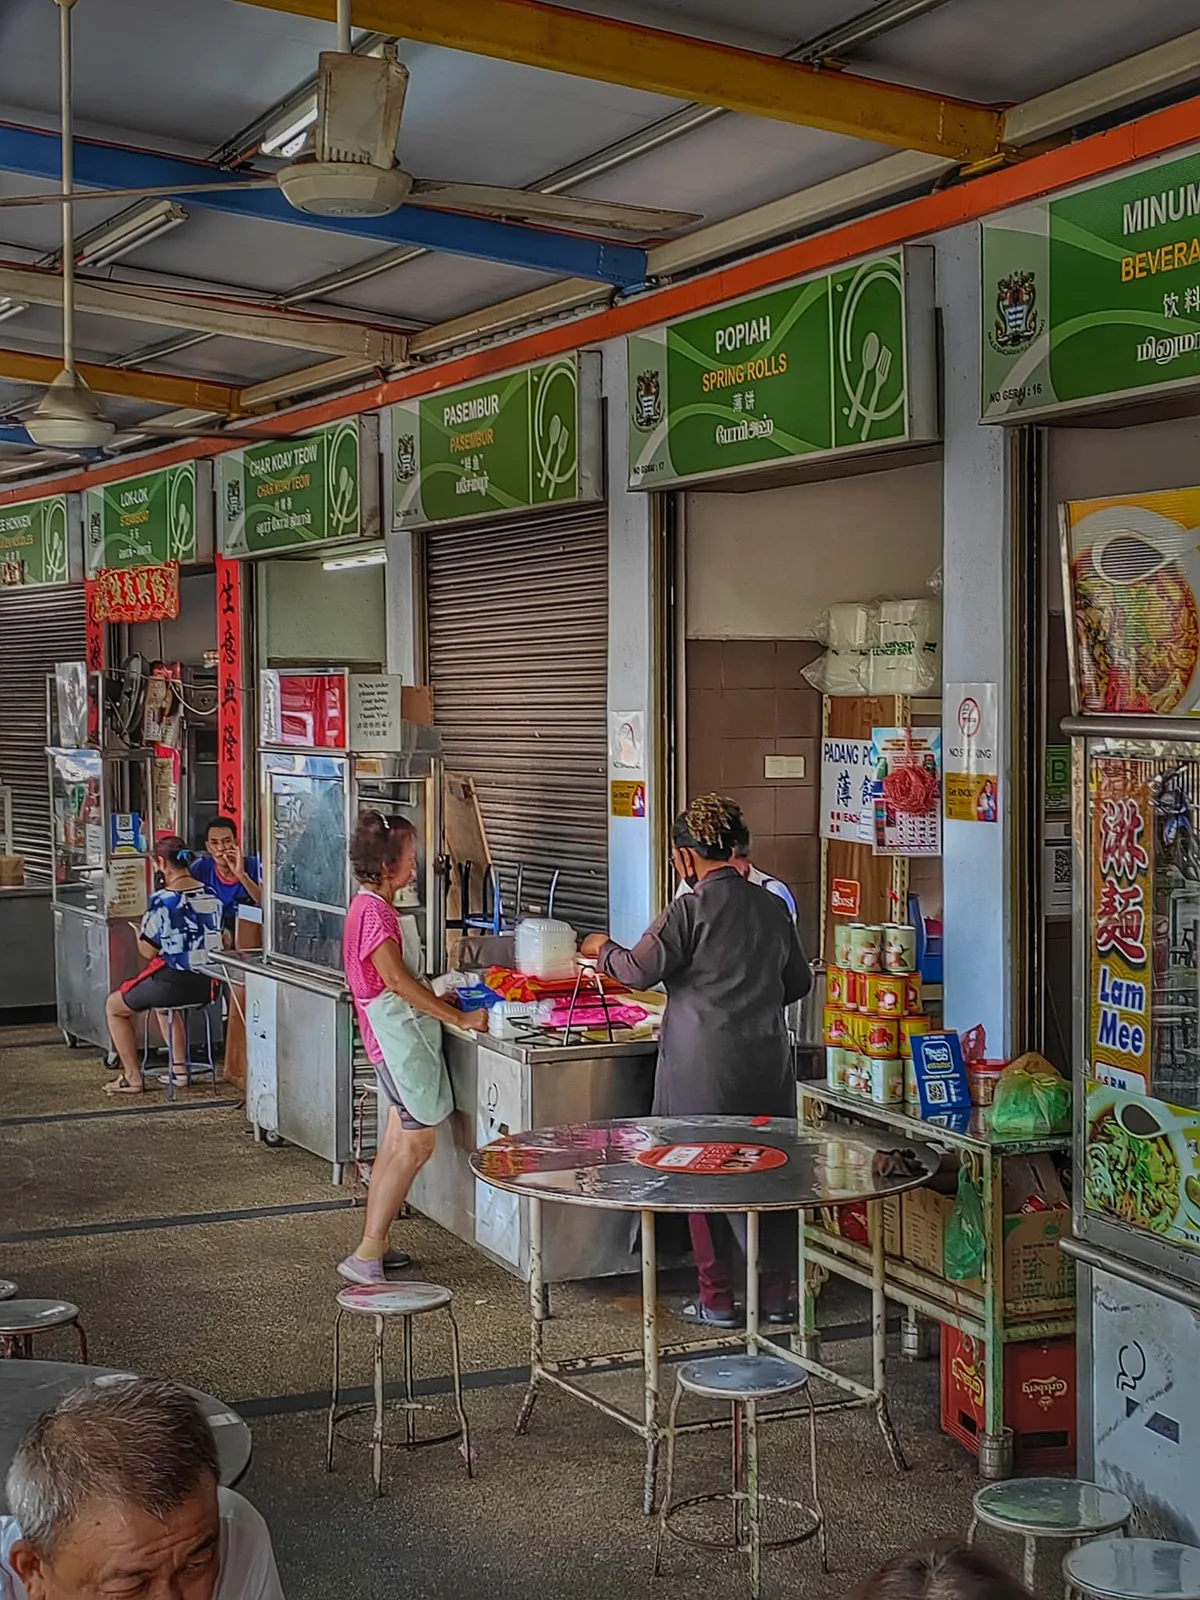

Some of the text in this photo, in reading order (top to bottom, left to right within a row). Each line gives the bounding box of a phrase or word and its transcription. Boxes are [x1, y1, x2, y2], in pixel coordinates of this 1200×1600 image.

[715, 315, 771, 354] POPIAH
[702, 353, 788, 392] SPRING ROLLS
[1032, 383, 1043, 395] 16
[443, 394, 500, 427] PASEMBUR
[293, 444, 318, 466] TEOW
[450, 428, 494, 454] PASEMBUR
[824, 743, 859, 765] PADANG
[1100, 966, 1145, 1012] Lam
[1099, 1011, 1145, 1055] Mee
[1022, 1376, 1068, 1398] Carlsberg
